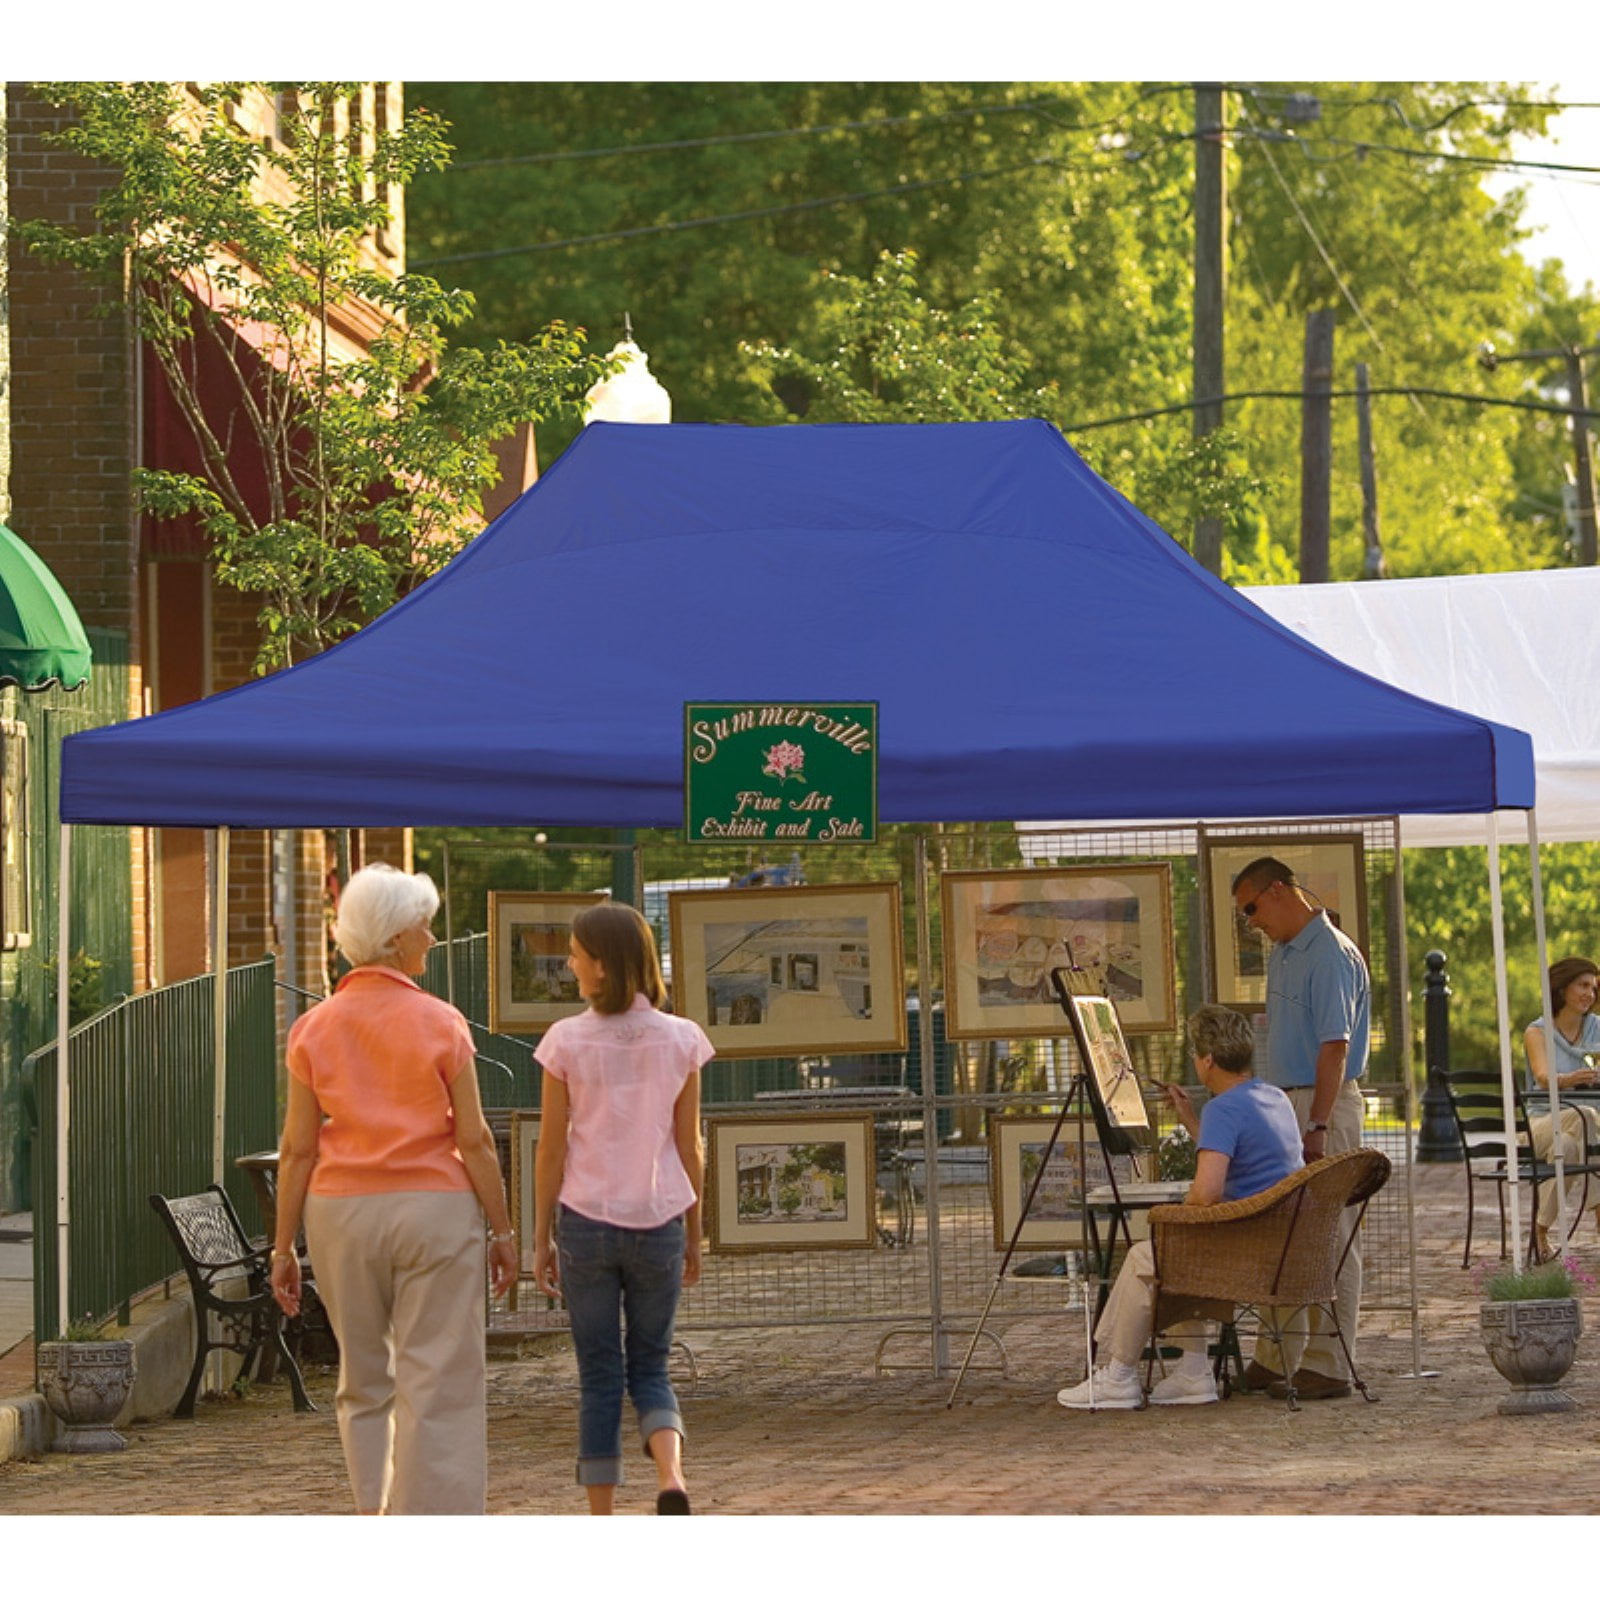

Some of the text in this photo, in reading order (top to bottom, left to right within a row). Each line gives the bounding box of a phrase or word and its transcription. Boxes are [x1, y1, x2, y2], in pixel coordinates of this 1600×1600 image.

[692, 706, 871, 764] Summerville
[731, 791, 833, 816] Fine Art
[701, 816, 865, 842] Exhibit and Sale
